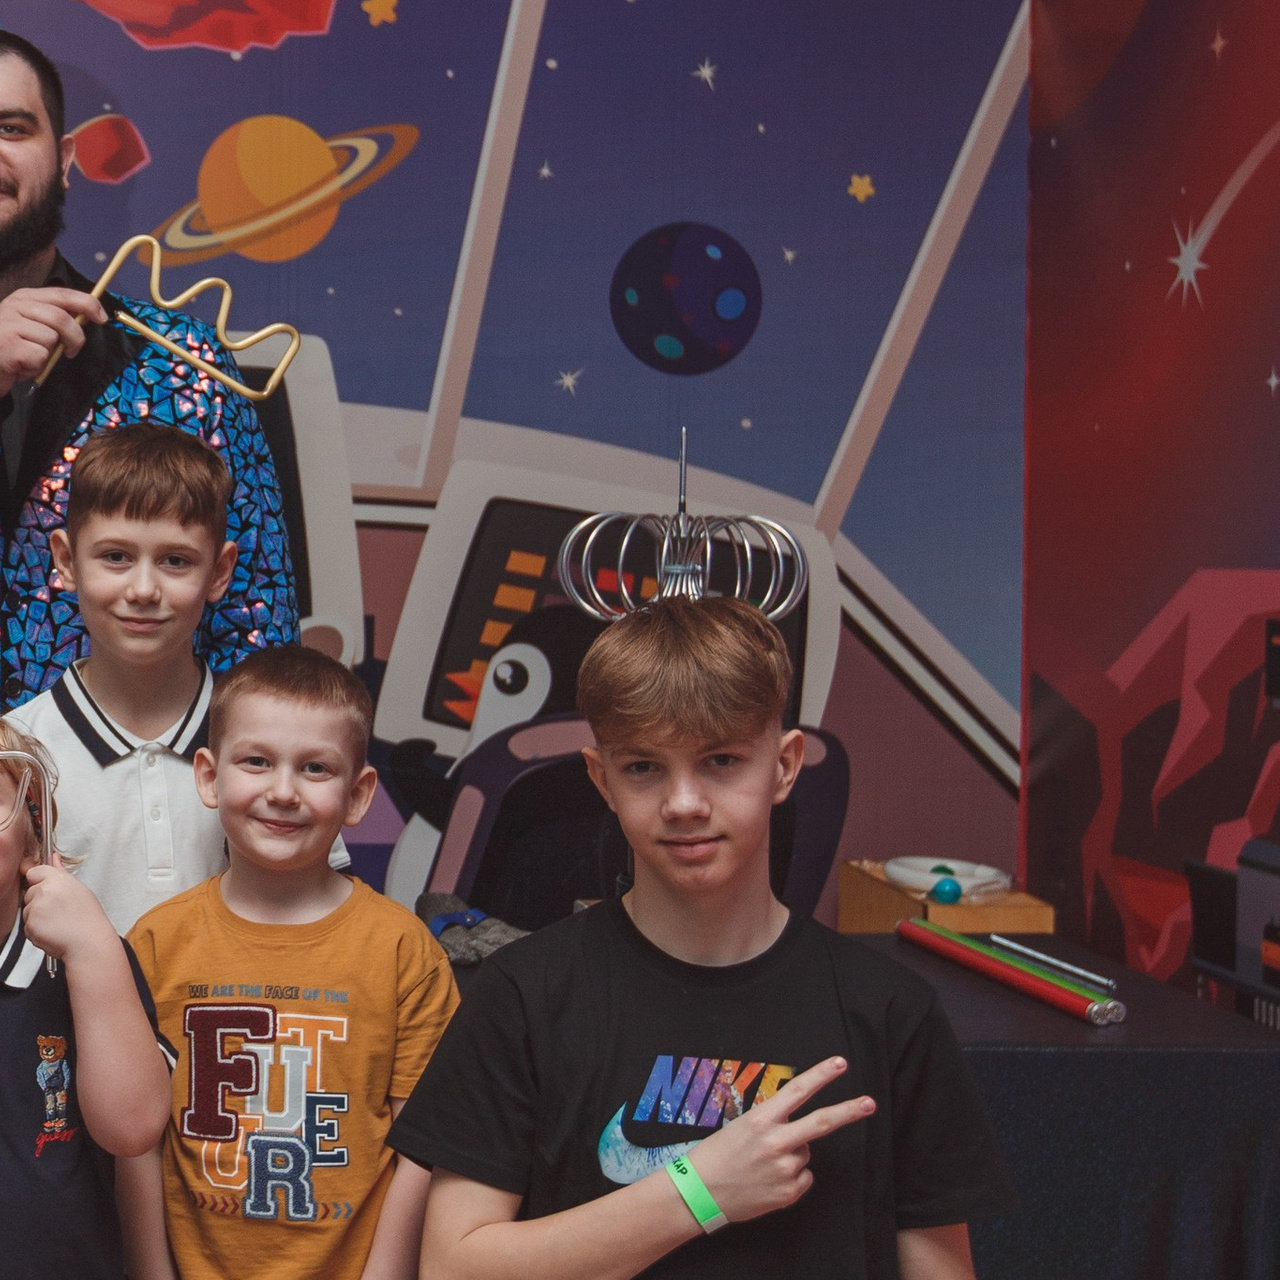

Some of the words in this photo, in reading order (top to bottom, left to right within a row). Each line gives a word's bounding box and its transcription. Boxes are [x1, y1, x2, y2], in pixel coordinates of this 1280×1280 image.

[188, 985, 209, 998] WE
[212, 985, 234, 997] ARE
[237, 985, 262, 998] THE
[265, 985, 300, 999] FACE
[302, 988, 320, 1001] OF
[324, 990, 349, 1003] THE
